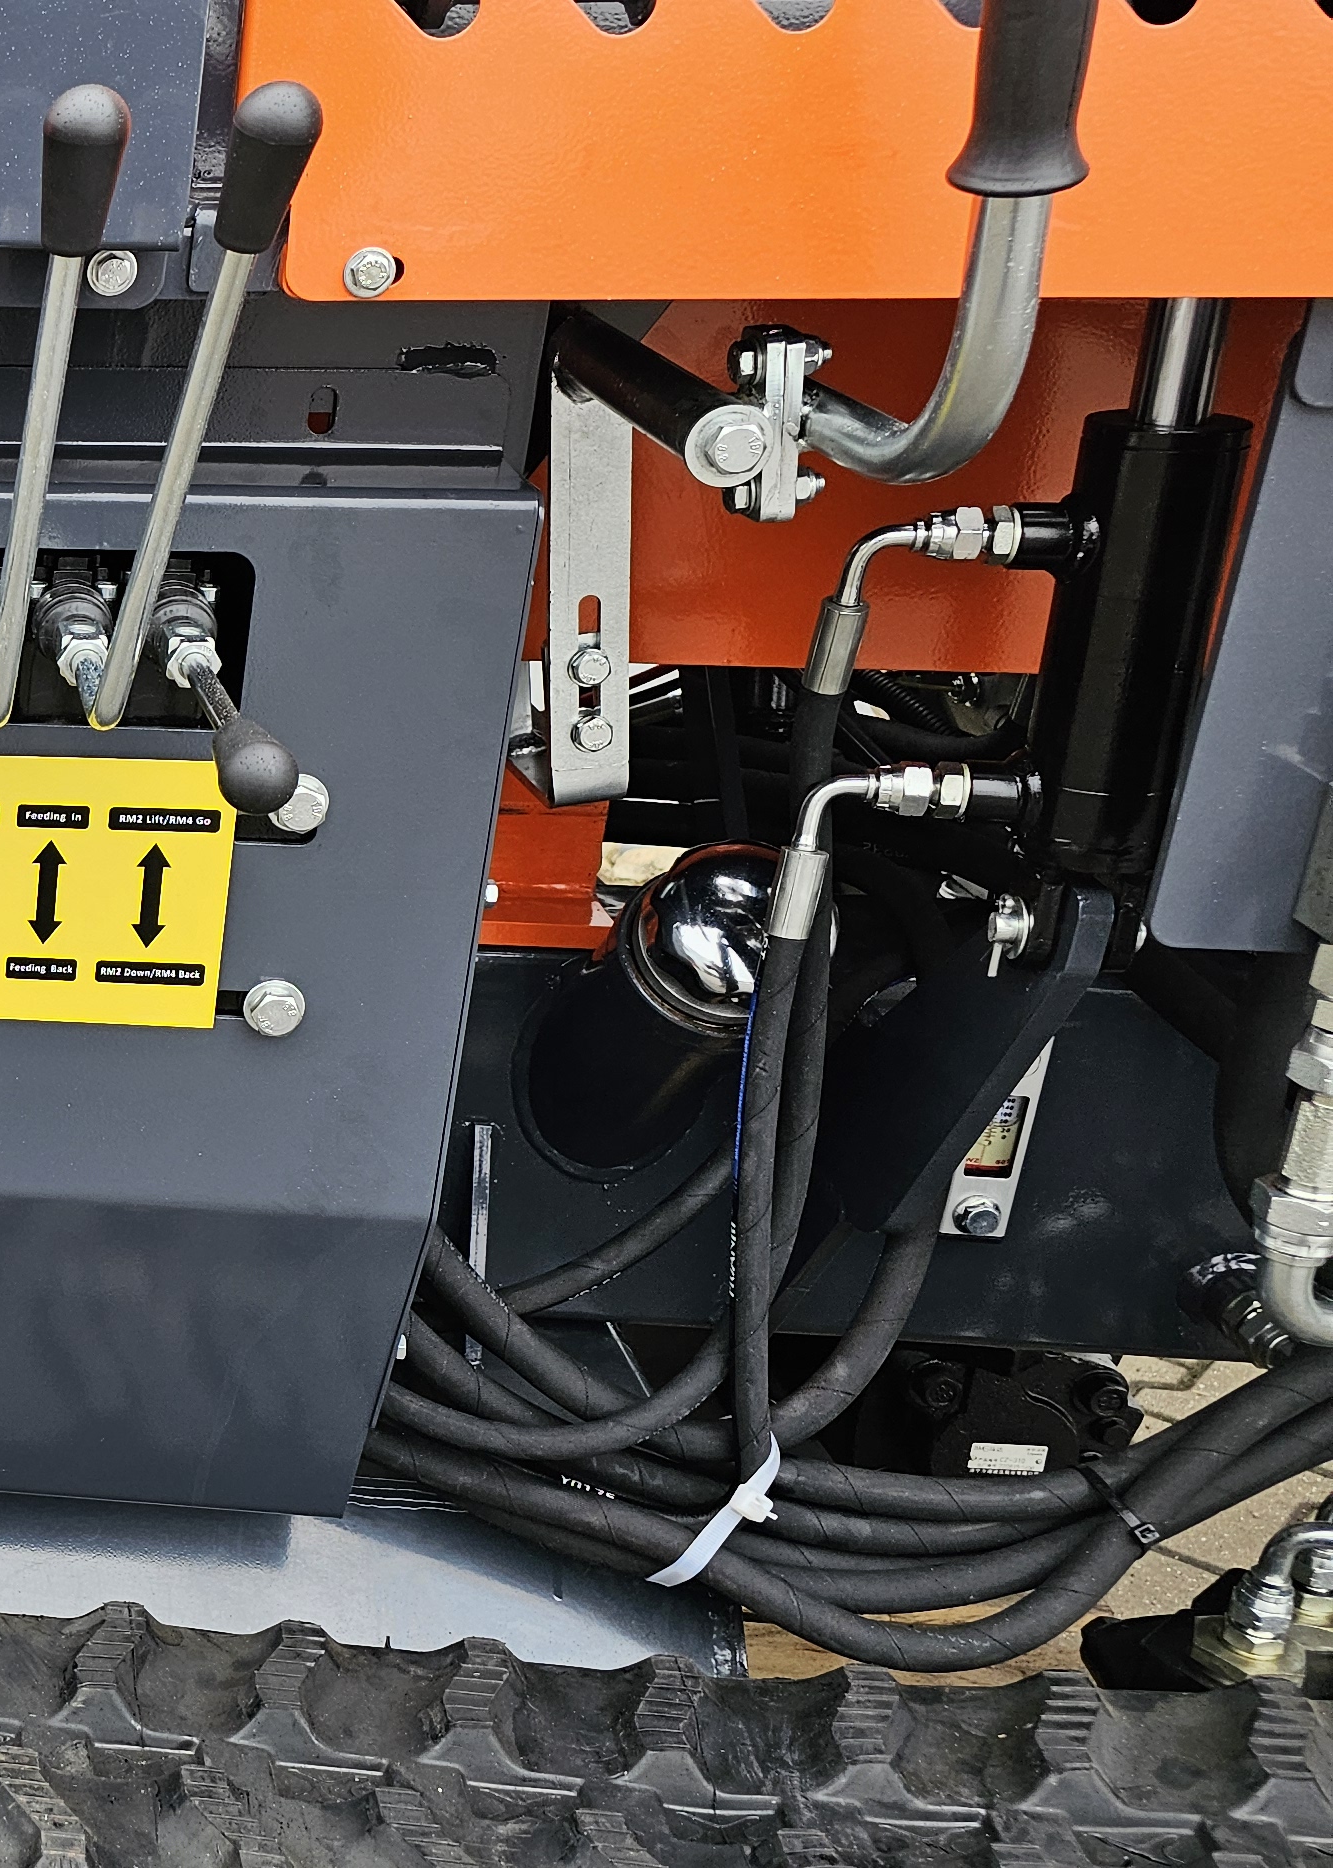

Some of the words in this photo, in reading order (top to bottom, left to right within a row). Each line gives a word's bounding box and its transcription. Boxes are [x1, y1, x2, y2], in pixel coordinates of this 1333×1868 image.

[25, 810, 67, 823] Feeding
[118, 814, 143, 824] RM2
[146, 814, 194, 826] Lift/RM4
[195, 816, 212, 826] Go
[9, 962, 47, 975] Feeding
[50, 964, 73, 974] Back
[100, 966, 122, 976] RM2
[123, 967, 177, 979] Down/RM4
[178, 970, 201, 979] Back
